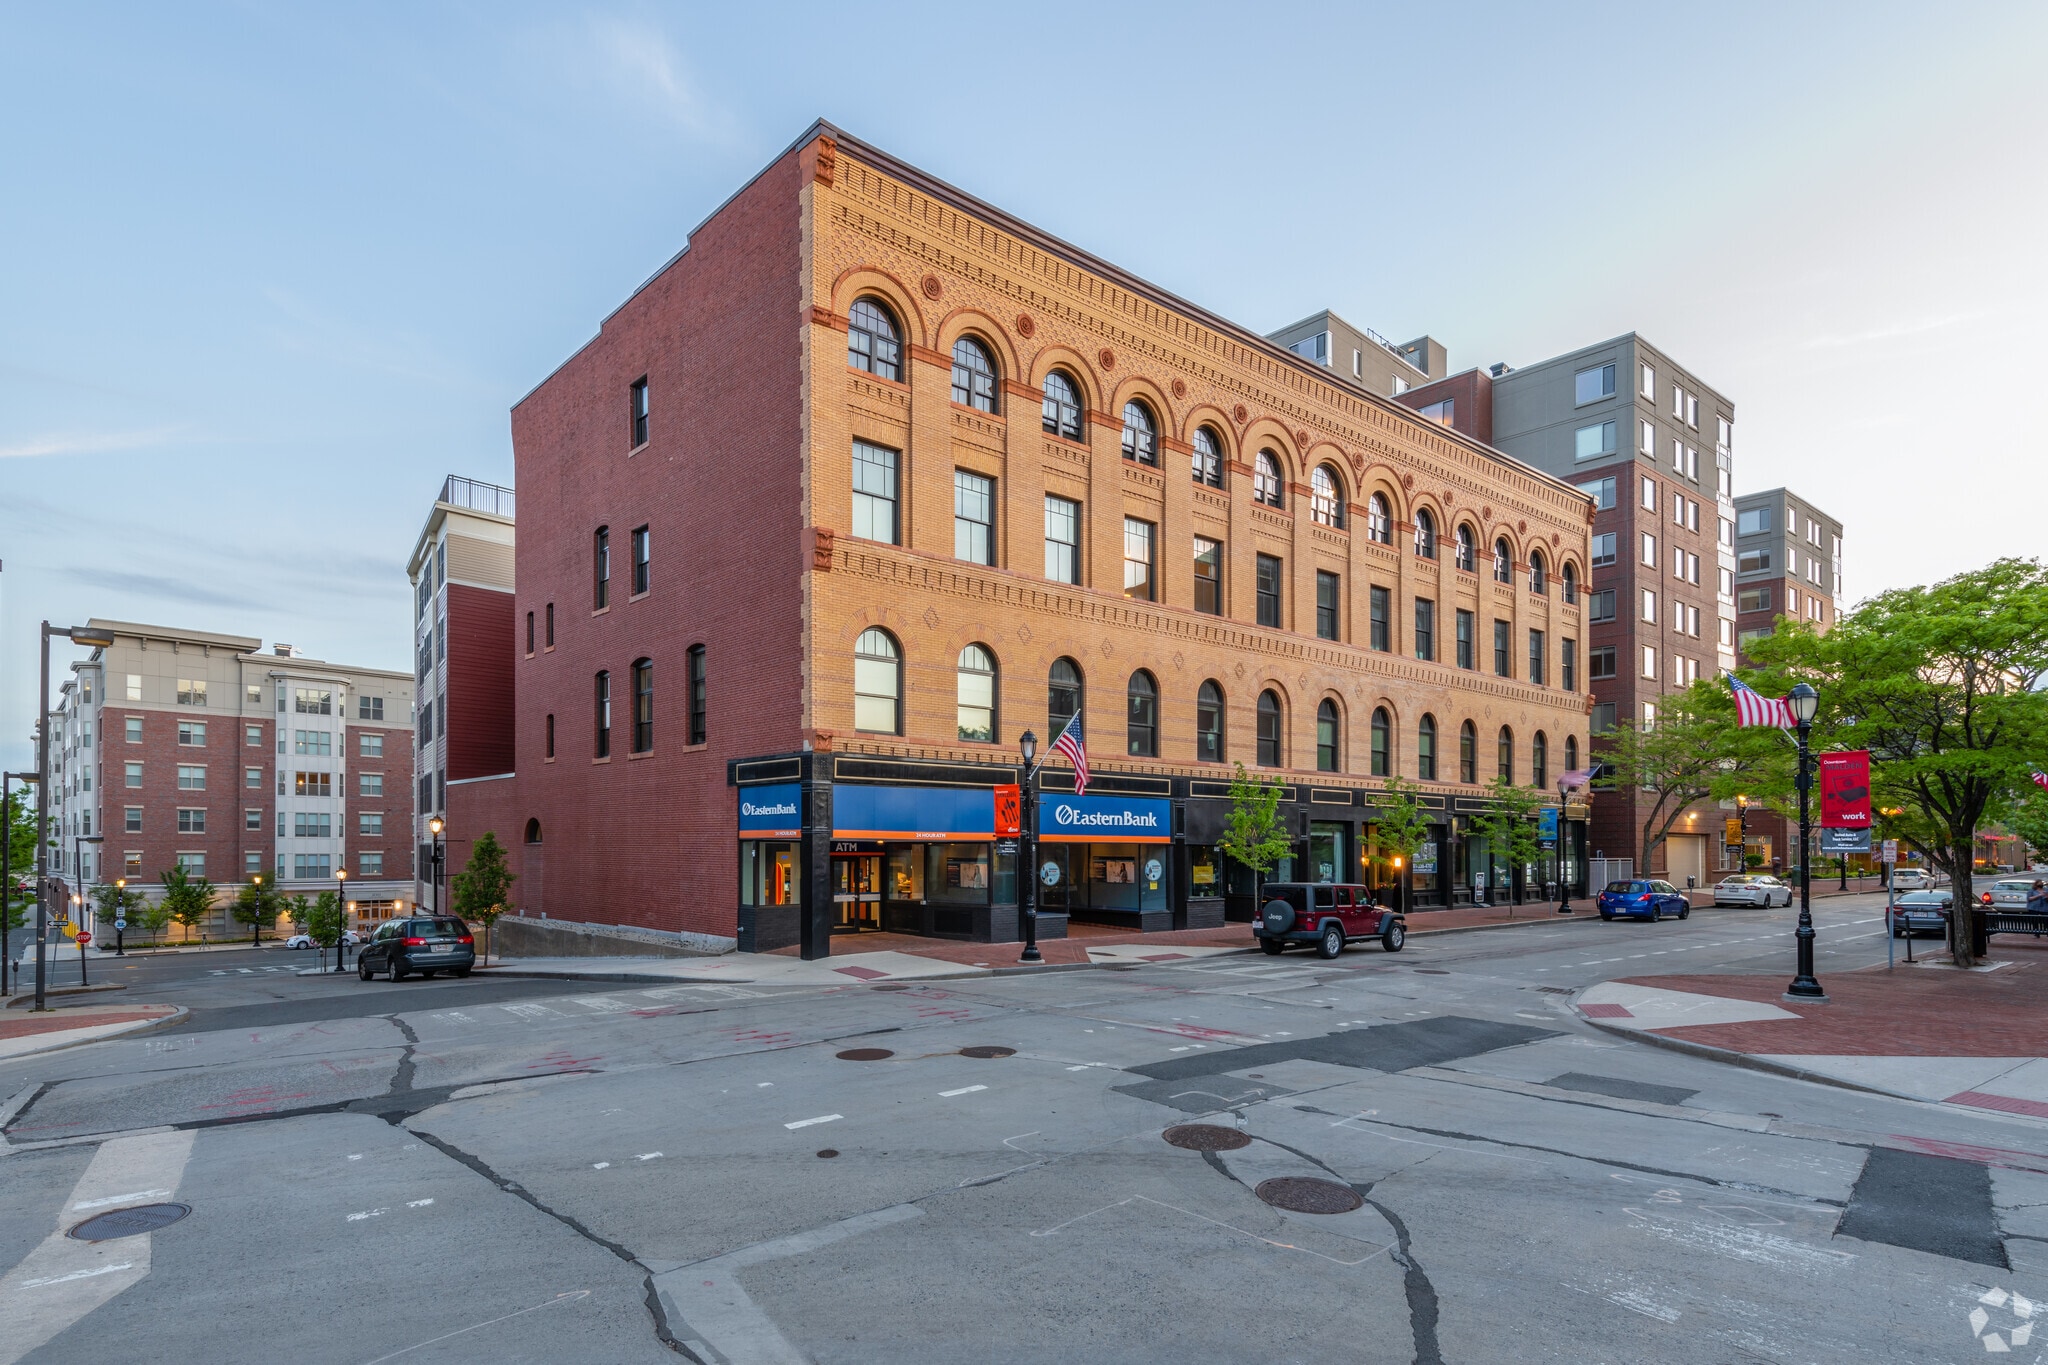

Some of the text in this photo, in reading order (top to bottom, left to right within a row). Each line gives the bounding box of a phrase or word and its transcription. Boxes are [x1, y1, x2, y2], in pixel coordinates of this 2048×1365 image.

[1825, 762, 1863, 770] MALDEN
[751, 803, 797, 816] EasternBank
[1072, 810, 1158, 826] EasternBank
[1842, 812, 1866, 820] work
[836, 842, 857, 852] ATM
